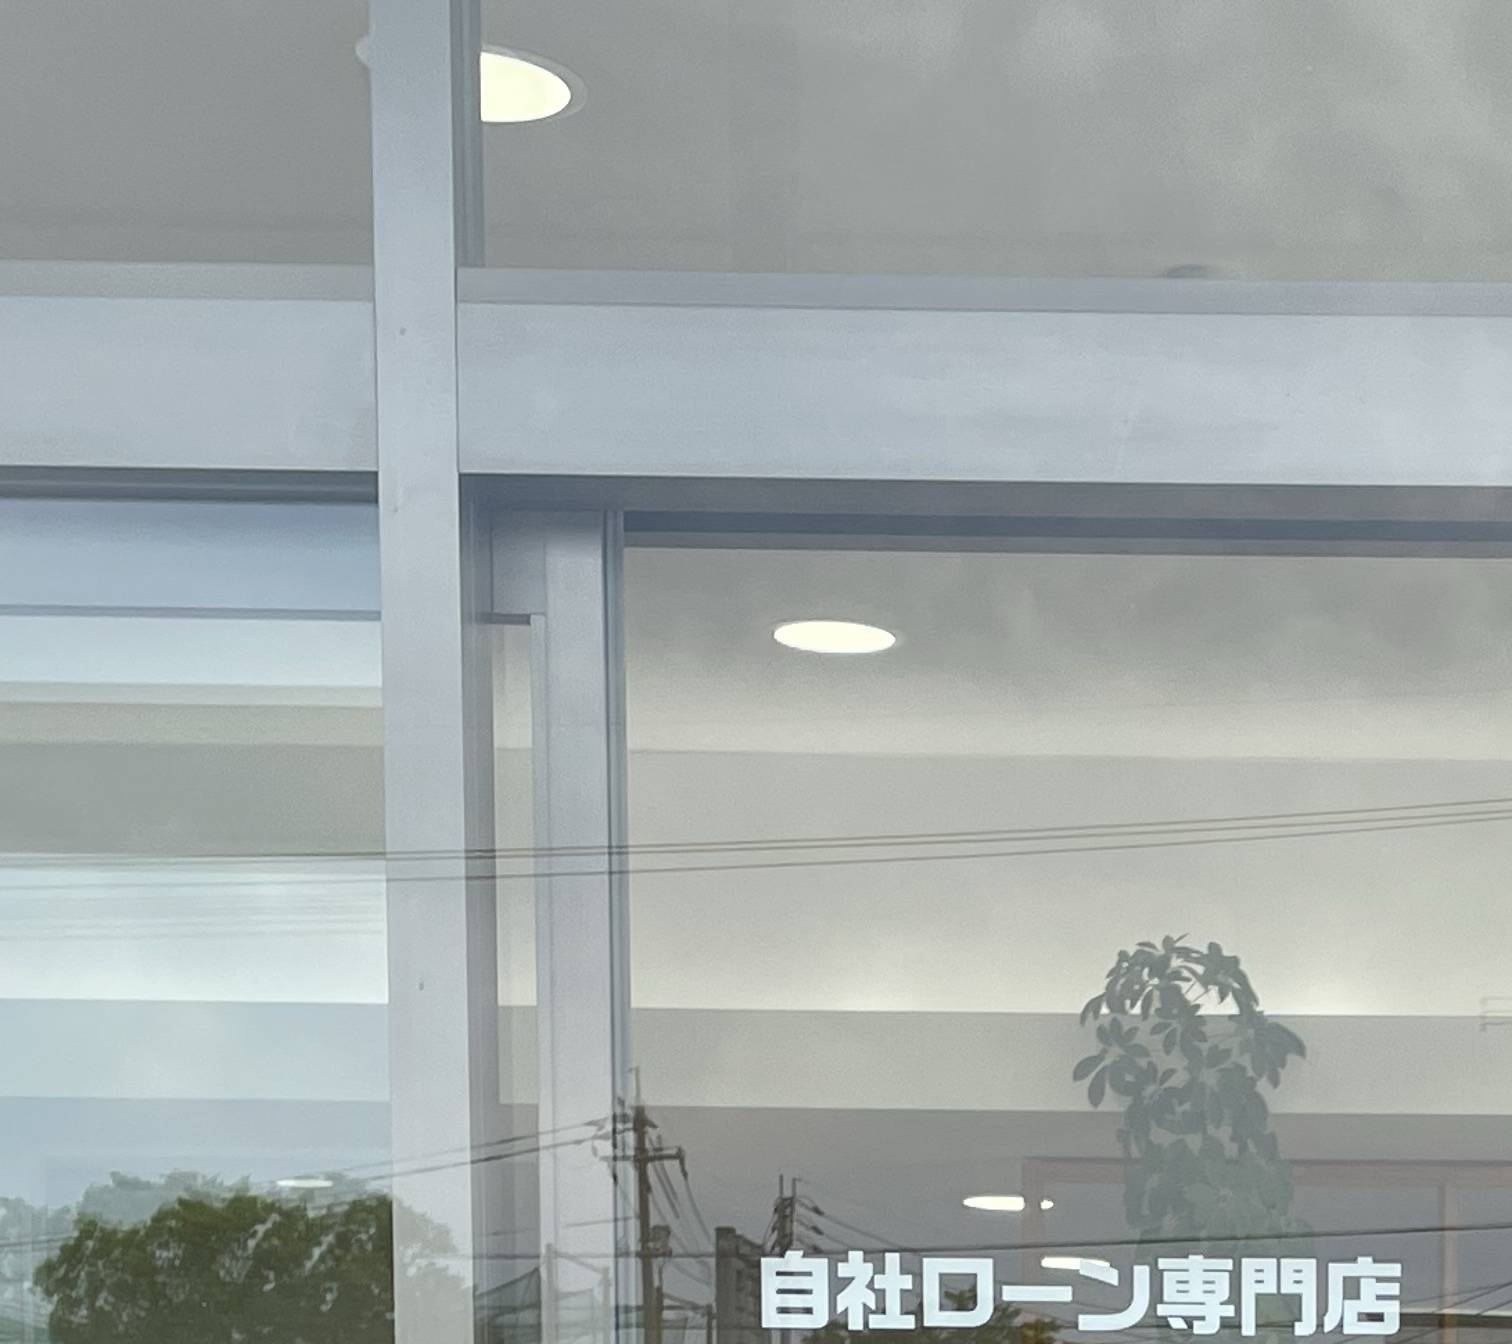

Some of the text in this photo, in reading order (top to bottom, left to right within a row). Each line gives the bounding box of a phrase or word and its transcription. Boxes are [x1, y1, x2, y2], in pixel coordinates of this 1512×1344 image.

[759, 1249, 1402, 1338] 自社ローン専門店
